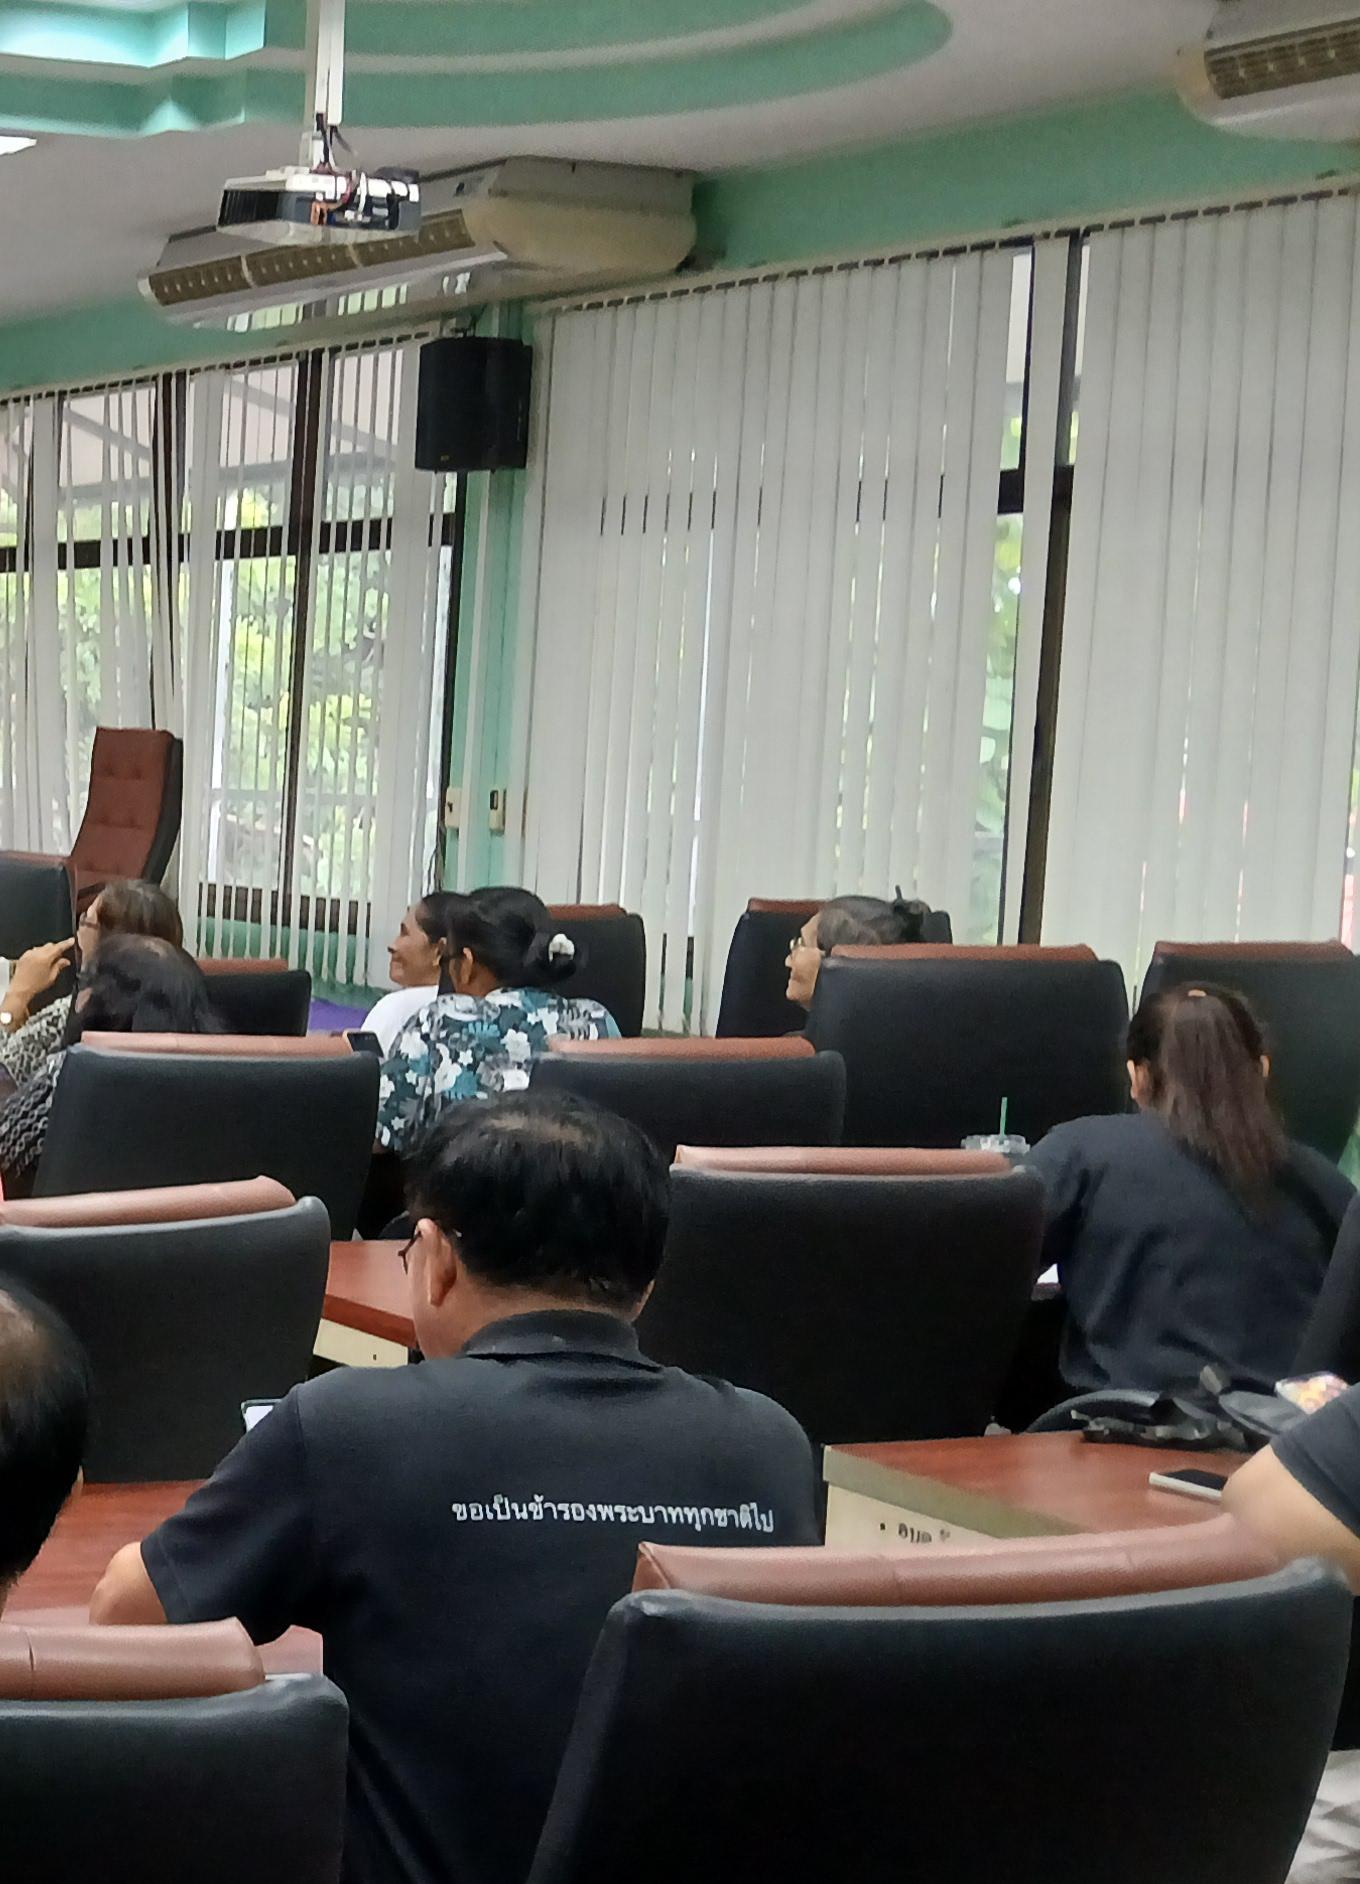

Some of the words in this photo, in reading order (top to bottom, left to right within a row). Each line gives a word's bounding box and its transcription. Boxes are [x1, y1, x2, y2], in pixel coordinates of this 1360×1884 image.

[451, 1493, 774, 1533] ขอเป็นข้ารองพระบาททุกชาติไป
